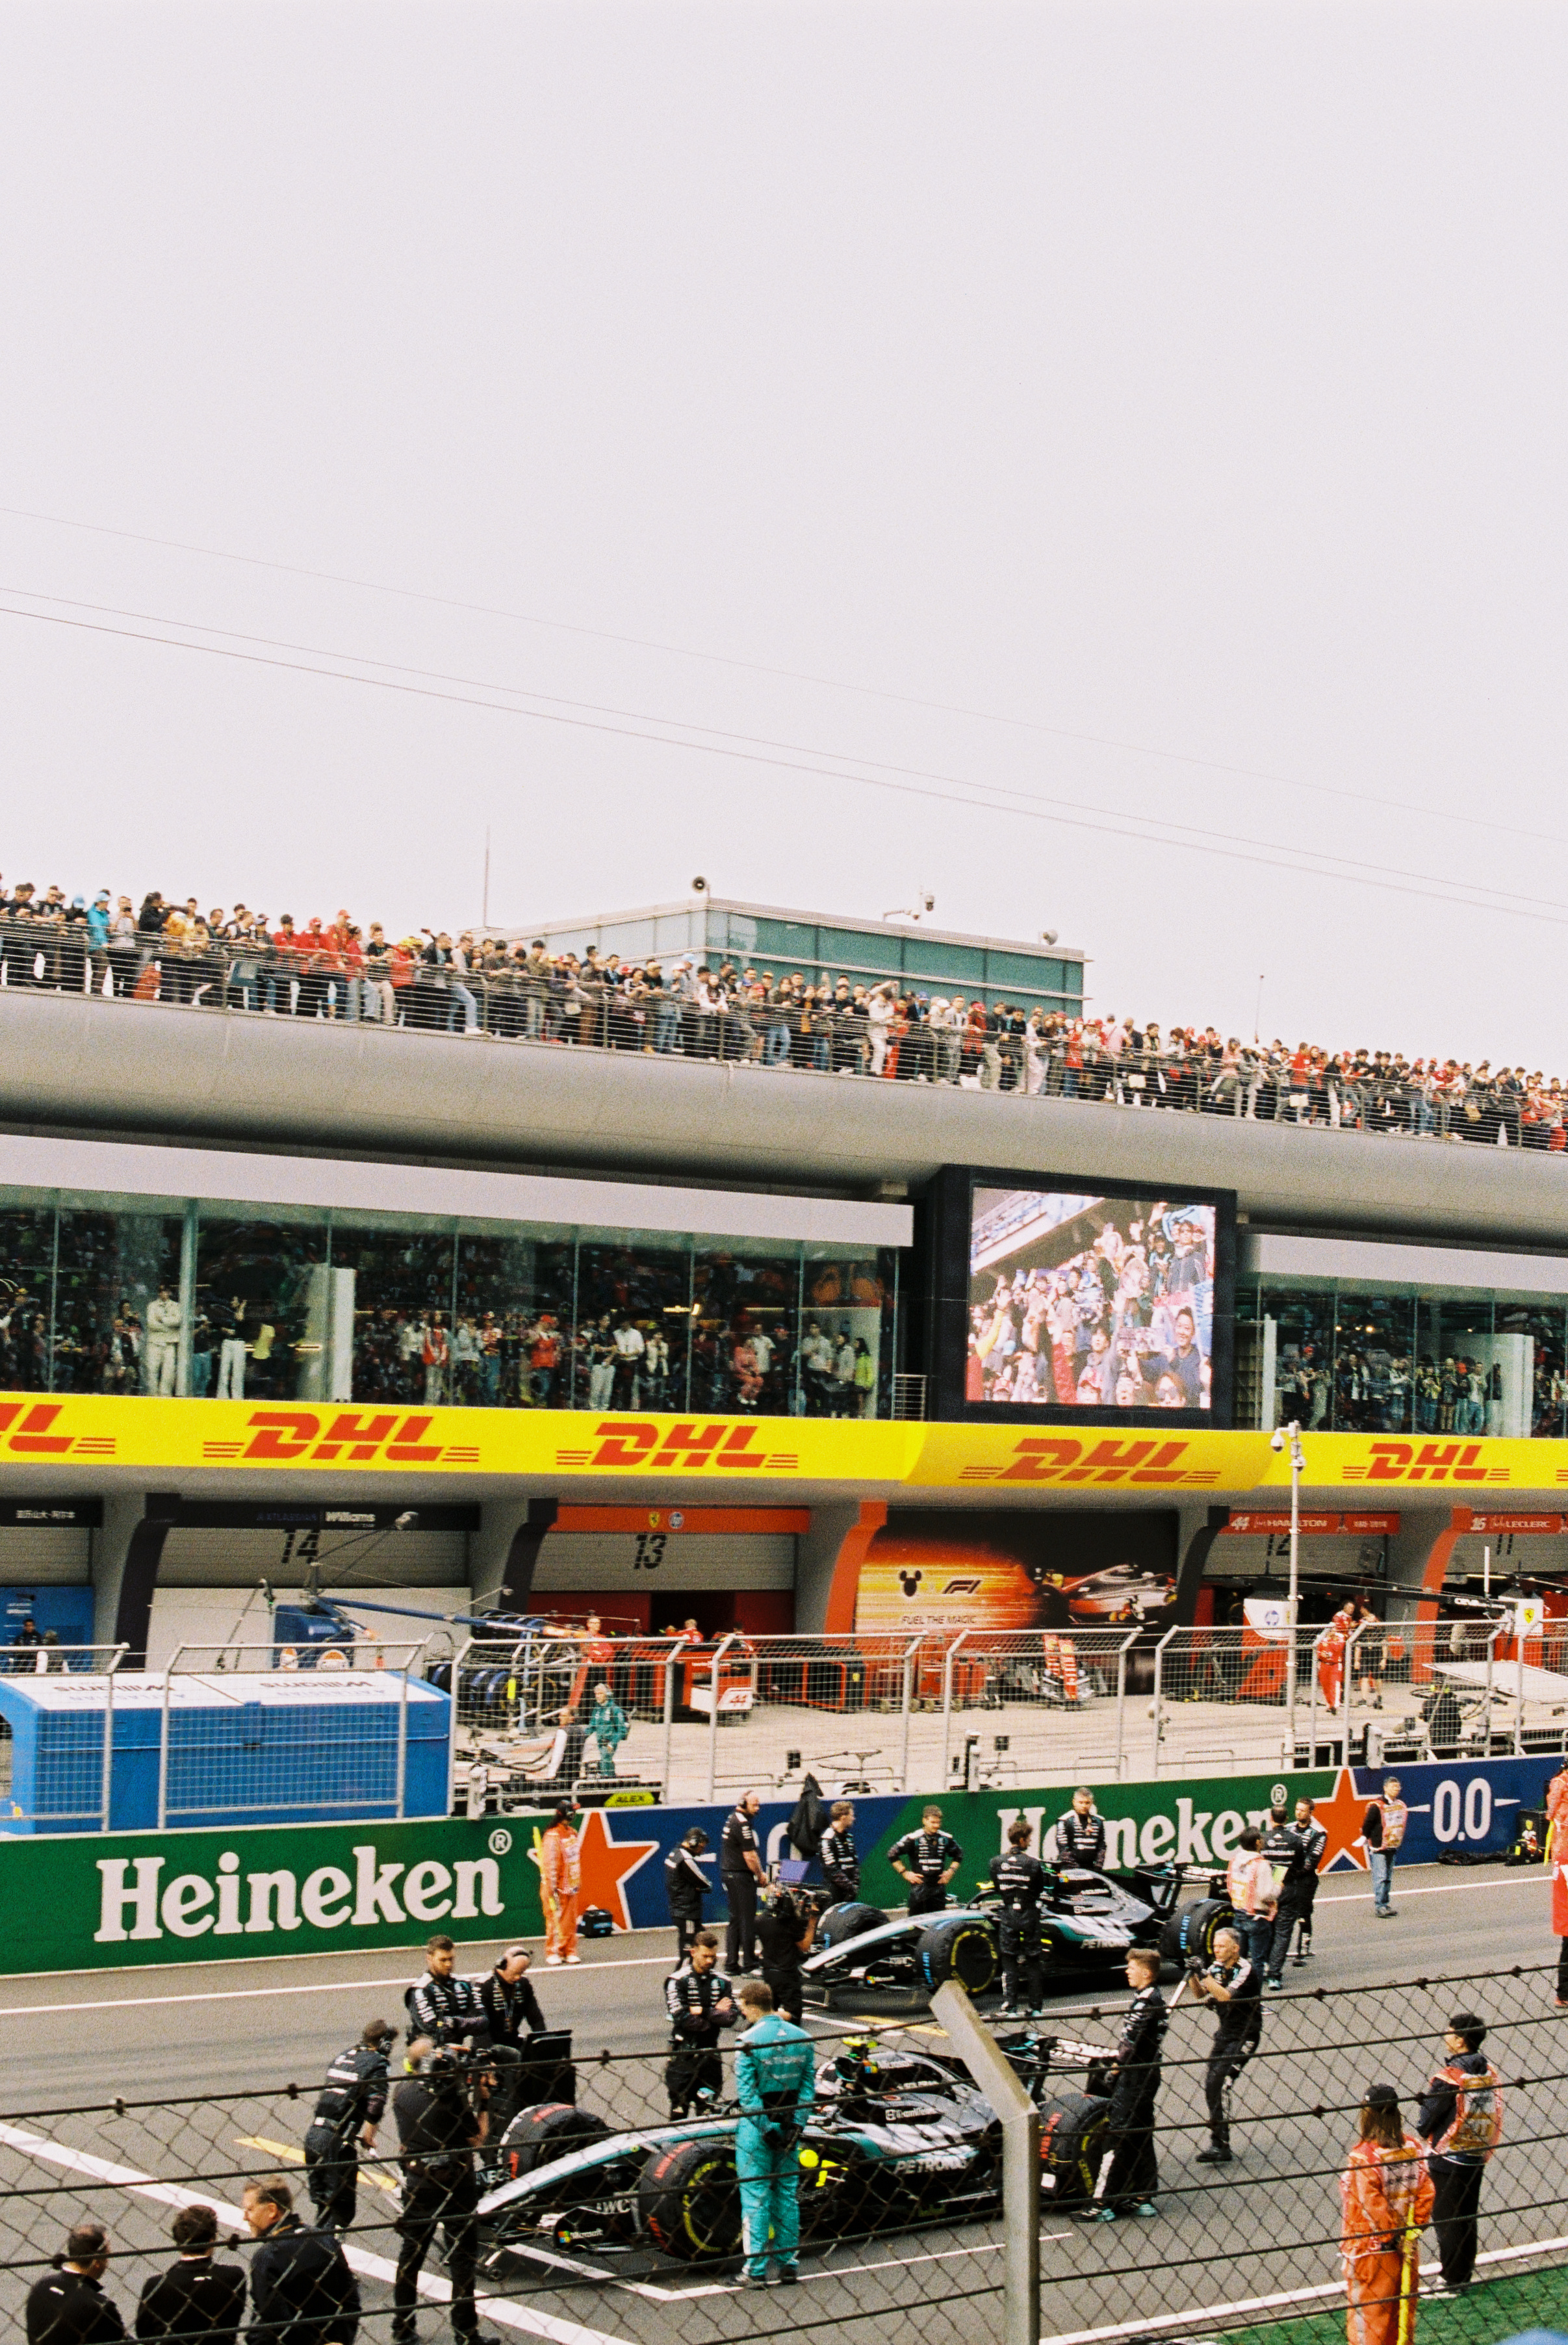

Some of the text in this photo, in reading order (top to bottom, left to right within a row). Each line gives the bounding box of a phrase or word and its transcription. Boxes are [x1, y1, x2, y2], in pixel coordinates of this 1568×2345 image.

[242, 1411, 443, 1461] DHL
[590, 1422, 767, 1468] DHL
[994, 1438, 1189, 1483] DHL
[1367, 1443, 1488, 1481] DHL
[325, 1511, 376, 1522] Williams
[1230, 1516, 1250, 1531] 44
[281, 1529, 321, 1564] 14
[634, 1534, 667, 1570] 13
[1496, 1533, 1514, 1555] 11
[901, 1615, 977, 1625] FUEL THE MAGIC
[730, 1694, 747, 1707] 44
[1433, 1778, 1491, 1843] 0.0
[93, 1846, 505, 1942] Heineken
